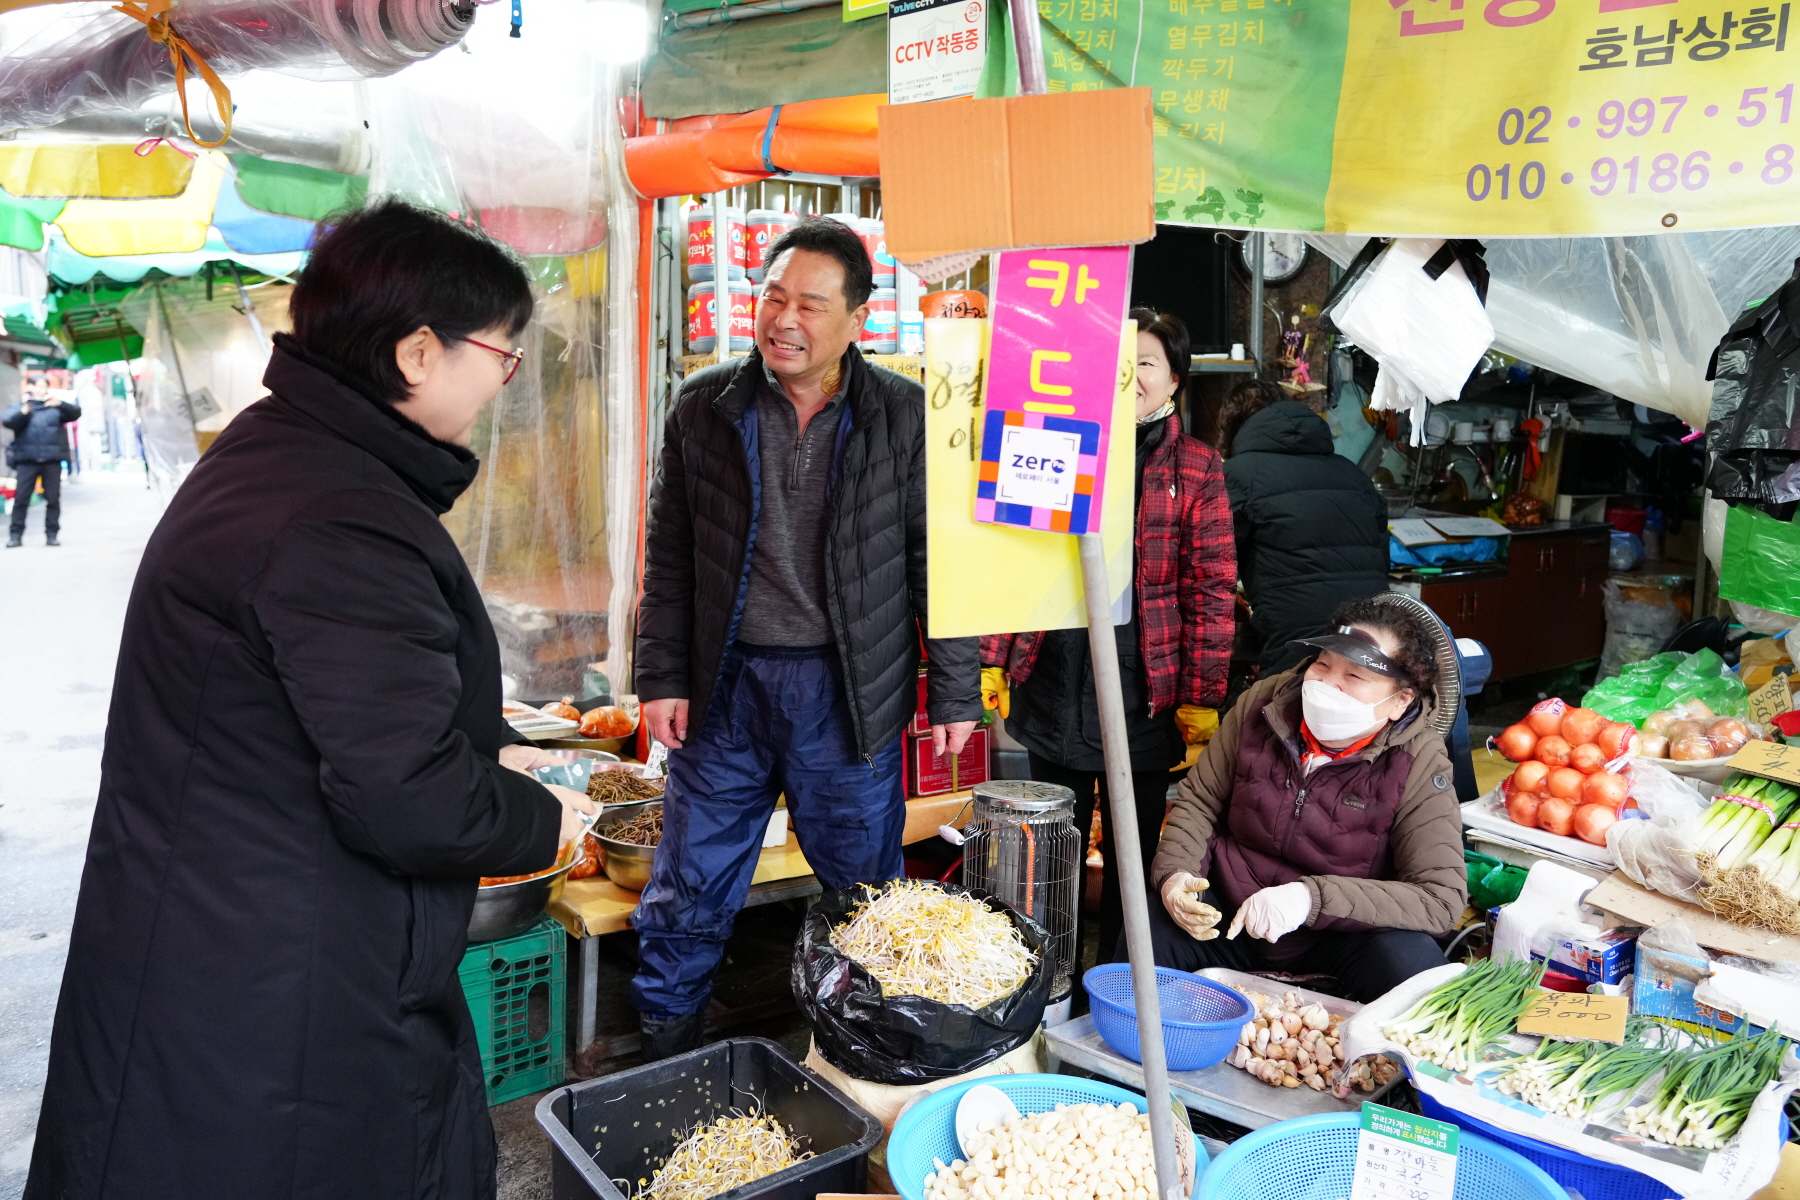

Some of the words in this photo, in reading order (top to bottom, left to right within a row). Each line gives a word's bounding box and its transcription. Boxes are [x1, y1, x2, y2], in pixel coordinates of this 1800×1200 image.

[1038, 0, 1118, 21] 포기김치
[895, 39, 934, 64] CCTV
[936, 28, 979, 55] 작동중
[1167, 18, 1265, 50] 열무김치
[1578, 3, 1790, 71] 호남상회
[1161, 55, 1236, 81] 깍두기
[1157, 87, 1230, 114] 무생채
[1496, 105, 1551, 146] 02
[1595, 95, 1688, 140] 997
[1736, 83, 1795, 128] 51
[1155, 165, 1206, 197] 김치
[1466, 161, 1546, 202] 010
[1588, 150, 1712, 197] 9186
[1760, 143, 1795, 186] 8
[1022, 258, 1100, 415] 카드
[1011, 454, 1067, 474] zero
[1371, 1113, 1412, 1131] 우리가게는
[1414, 1125, 1448, 1142] 원산지를
[1371, 1121, 1401, 1137] 정직하게
[1401, 1130, 1447, 1149] 표시했습니다
[1366, 1159, 1388, 1172] 원산지
